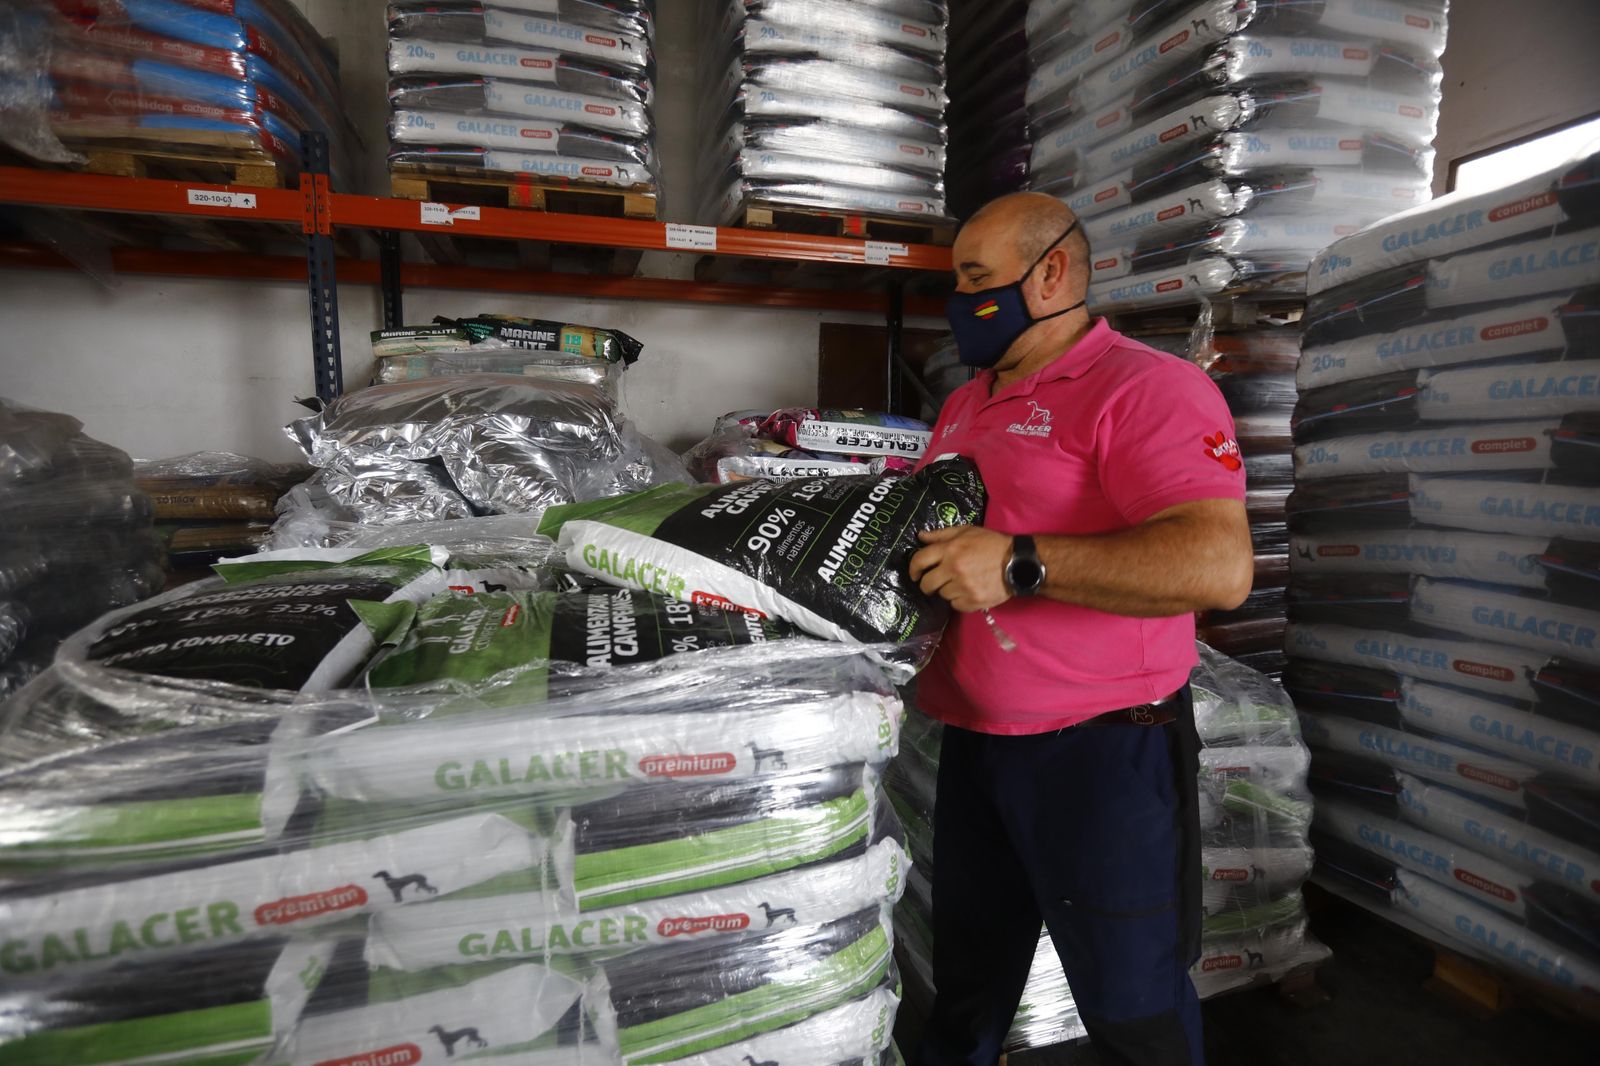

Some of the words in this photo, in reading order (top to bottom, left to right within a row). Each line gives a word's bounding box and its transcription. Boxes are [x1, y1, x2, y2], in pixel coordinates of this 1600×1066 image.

[523, 20, 584, 42] GALACER
[588, 35, 614, 47] complet
[406, 44, 435, 60] 20kg
[456, 49, 518, 67] GALACER
[523, 58, 551, 69] complet
[1054, 45, 1093, 76] GALACER
[1109, 45, 1158, 82] GALACER
[1290, 42, 1340, 57] GALACER
[523, 92, 583, 113] GALACER
[587, 104, 613, 117] complet
[406, 114, 435, 130] 20kg
[456, 119, 518, 137] GALACER
[523, 128, 551, 139] complet
[1110, 133, 1158, 163] GALACER
[521, 159, 580, 177] GALACER
[584, 166, 610, 177] complet
[194, 194, 232, 203] 320-10-03
[1110, 211, 1156, 235] GALACER
[1319, 254, 1352, 275] 20kg
[1382, 209, 1484, 253] GALACER
[1495, 194, 1553, 219] complet
[1488, 242, 1600, 281] GALACE
[1110, 281, 1154, 301] GALACER
[381, 330, 417, 338] MARINE
[500, 327, 556, 342] MARINE
[504, 339, 547, 351] ELITE
[564, 334, 583, 345] 18
[1312, 354, 1346, 374] 20kg
[1376, 326, 1476, 361] GALACER
[1487, 319, 1541, 339] complet
[1488, 376, 1600, 401] GALACE
[836, 436, 919, 452] GALACER
[1306, 447, 1339, 465] 20kg
[1369, 436, 1467, 460] GALACER
[1478, 438, 1528, 452] complet
[747, 508, 797, 555] 90%
[775, 519, 806, 557] alimentos
[786, 525, 816, 563] naturales
[817, 502, 876, 584] ALIMENTO
[832, 554, 864, 592] RICO
[856, 532, 879, 556] EN
[869, 490, 906, 534] POLLO
[1364, 544, 1458, 565] GALACER
[583, 544, 686, 602] GALACER
[267, 602, 339, 617] 33%
[898, 614, 911, 634] sabor
[170, 632, 297, 650] COMPLETO
[1471, 605, 1598, 650] GALACER
[1295, 630, 1328, 651] 20kg
[1354, 638, 1449, 671] GALACER
[1458, 660, 1508, 679] complet
[1469, 714, 1595, 770] GALACER
[434, 748, 632, 791] GALACER
[643, 755, 731, 775] premium
[1358, 728, 1454, 772] GALACER
[1461, 766, 1511, 789] complet
[1358, 823, 1453, 875] GALACER
[1459, 871, 1509, 899] complet
[1463, 818, 1586, 885] GALACER
[0, 900, 245, 974] GALACER
[262, 887, 360, 923] premium
[459, 915, 649, 956] GALACER
[661, 915, 744, 938] premium
[1454, 914, 1576, 986] GALACER
